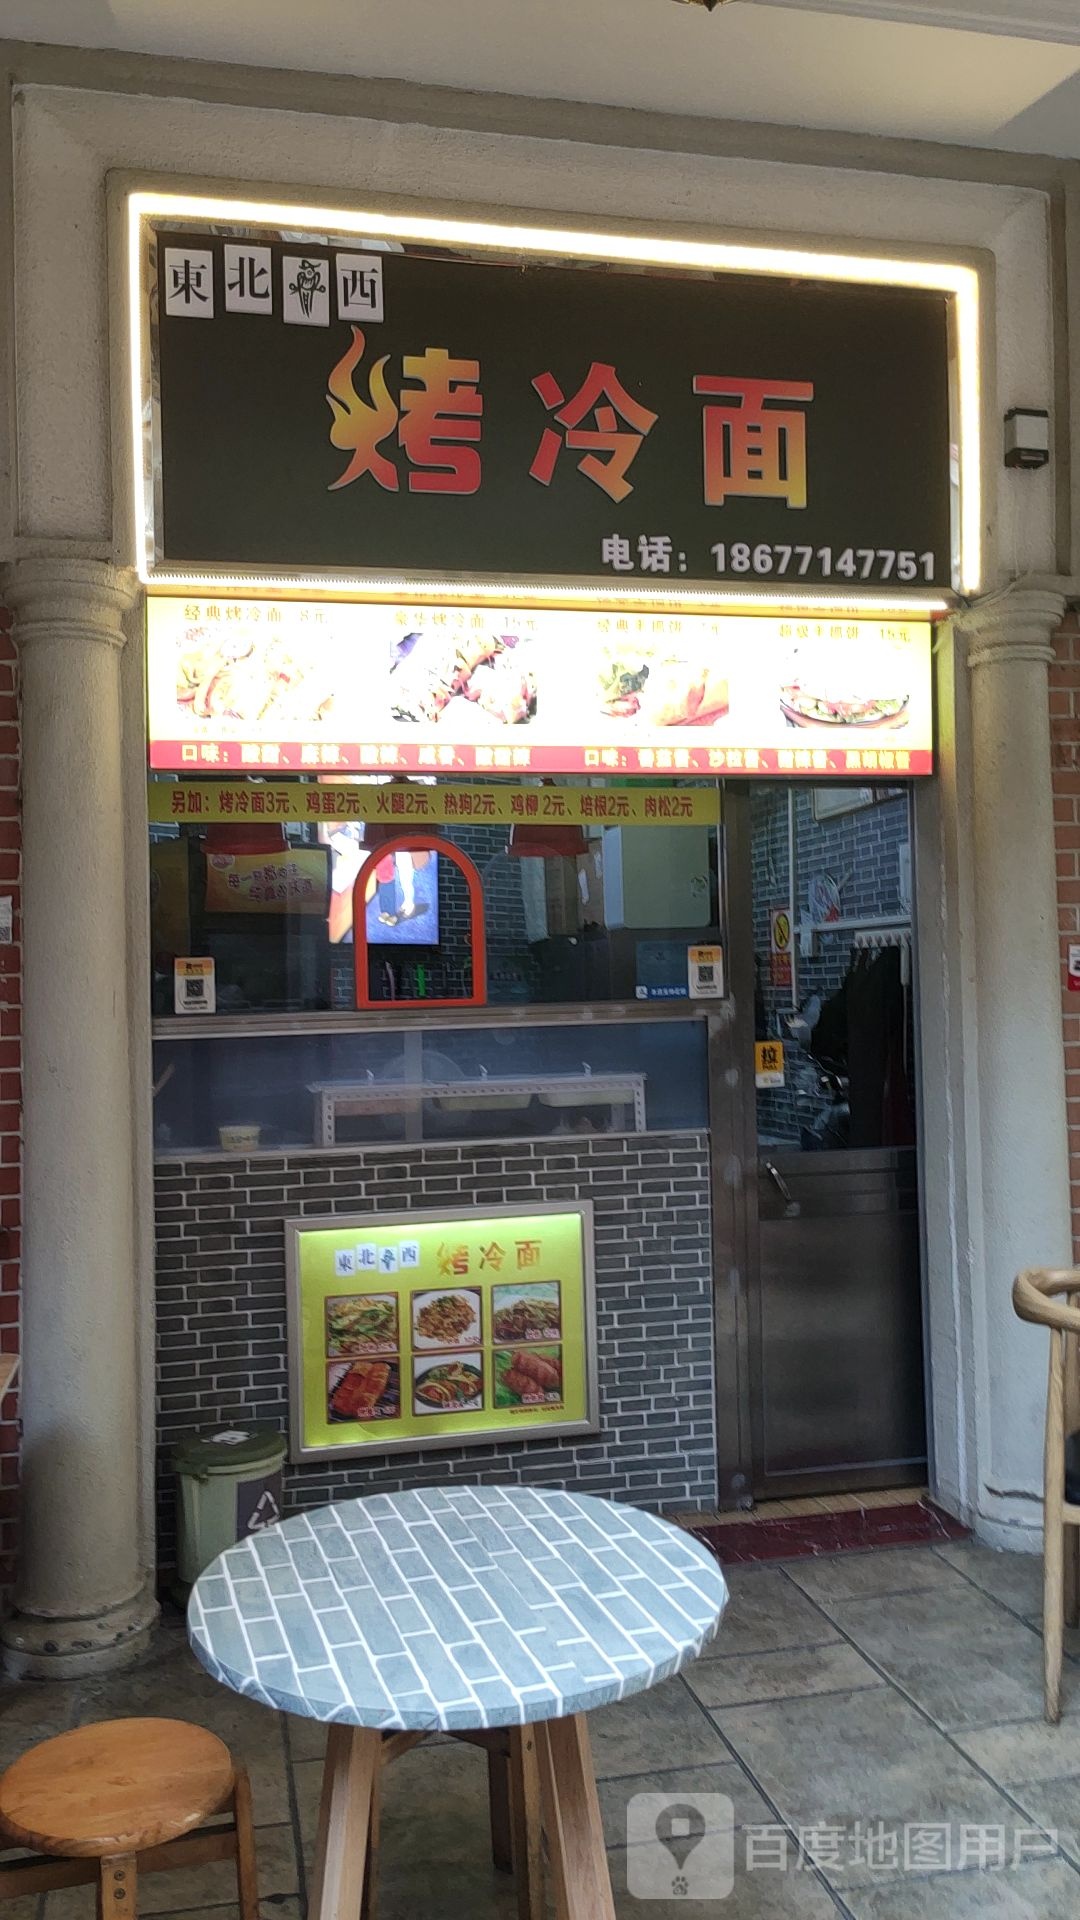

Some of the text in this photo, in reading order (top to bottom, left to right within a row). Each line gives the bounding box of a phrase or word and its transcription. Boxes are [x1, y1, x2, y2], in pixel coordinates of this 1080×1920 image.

[325, 324, 814, 509] 烤冷面
[436, 1239, 542, 1276] 烤冷面
